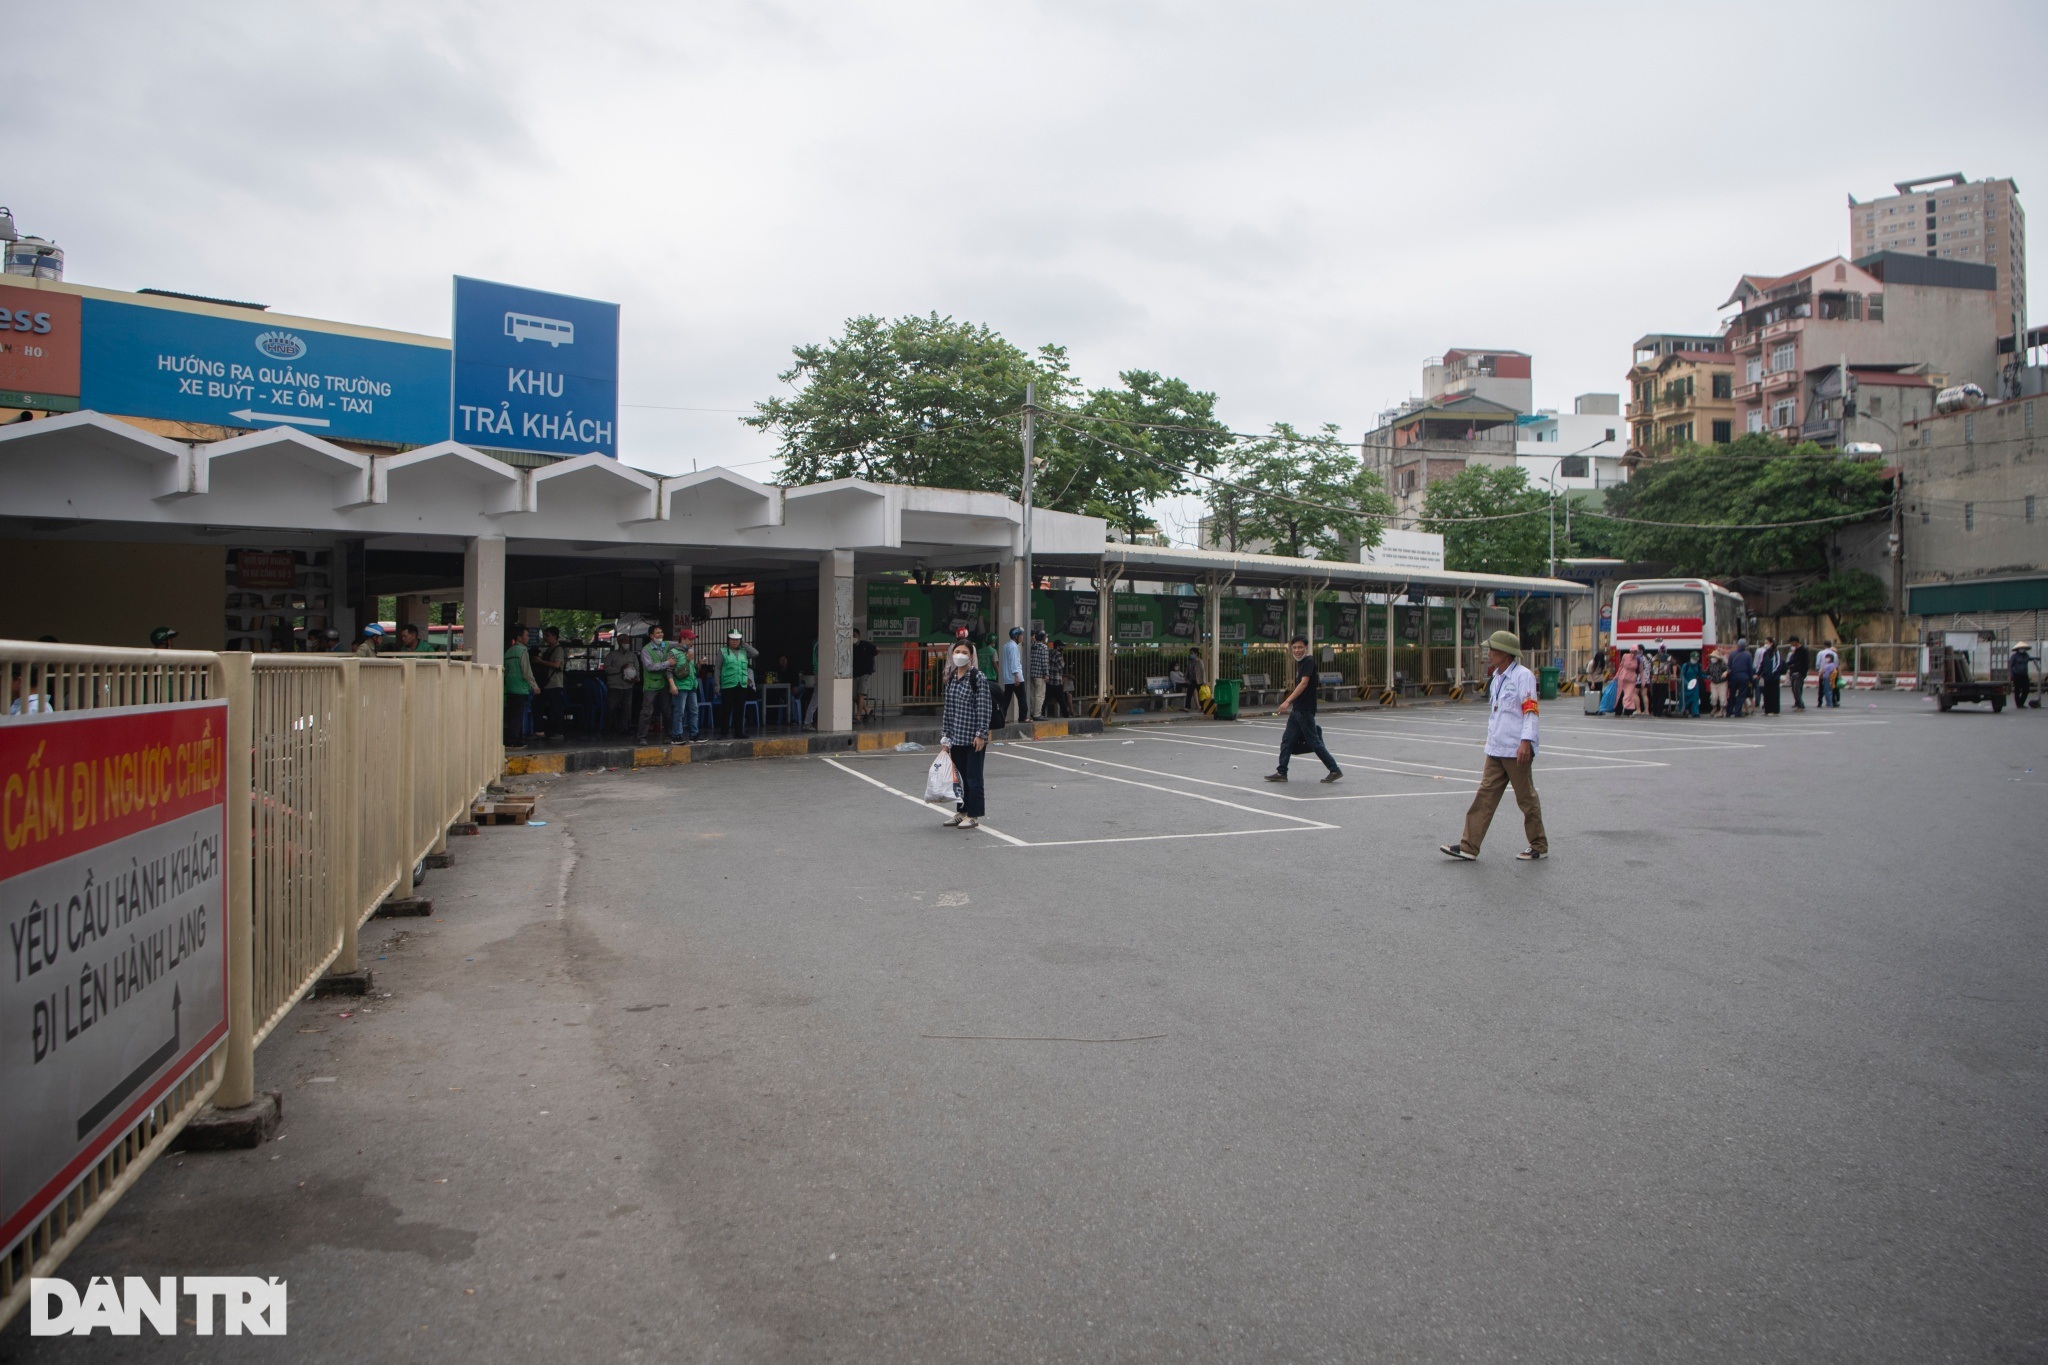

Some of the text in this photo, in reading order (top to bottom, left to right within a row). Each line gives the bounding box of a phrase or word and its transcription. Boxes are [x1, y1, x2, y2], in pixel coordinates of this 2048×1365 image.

[266, 343, 296, 354] HNB
[158, 354, 392, 397] HƯỚNG RA QUẢNG TRƯỜNG
[179, 378, 203, 395] XE
[208, 380, 254, 401] BUÝT
[271, 389, 293, 405] XE
[298, 391, 323, 409] ÔM
[340, 397, 373, 414] TAXI
[508, 367, 564, 398] KHU
[459, 401, 612, 445] TRẢ KHÁCH
[3, 717, 222, 850] CẤM ĐI NGƯỢC CHIỀU
[10, 830, 219, 983] YÊU CẦU HÀNH KHÁCH
[32, 904, 207, 1065] ĐI LÊN HÀNH LANG
